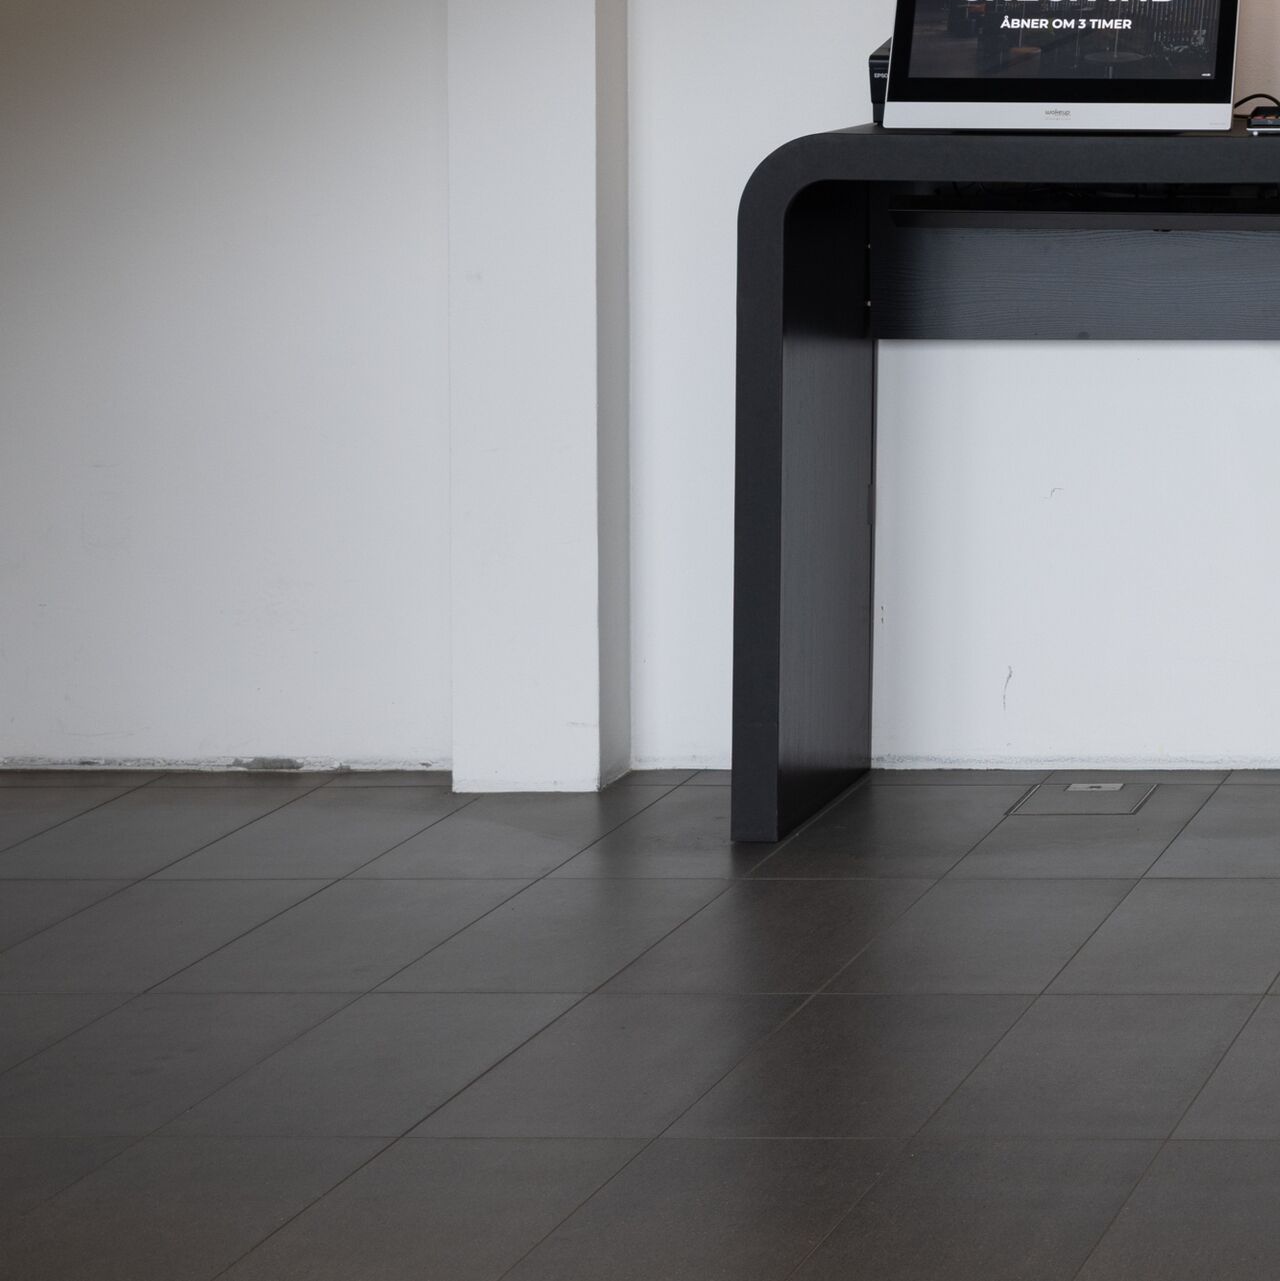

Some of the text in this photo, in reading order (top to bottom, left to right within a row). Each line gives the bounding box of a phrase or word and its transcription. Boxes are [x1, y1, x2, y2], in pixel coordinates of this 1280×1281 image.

[1000, 15, 1132, 29] ÅBNER OM 3 TIMER
